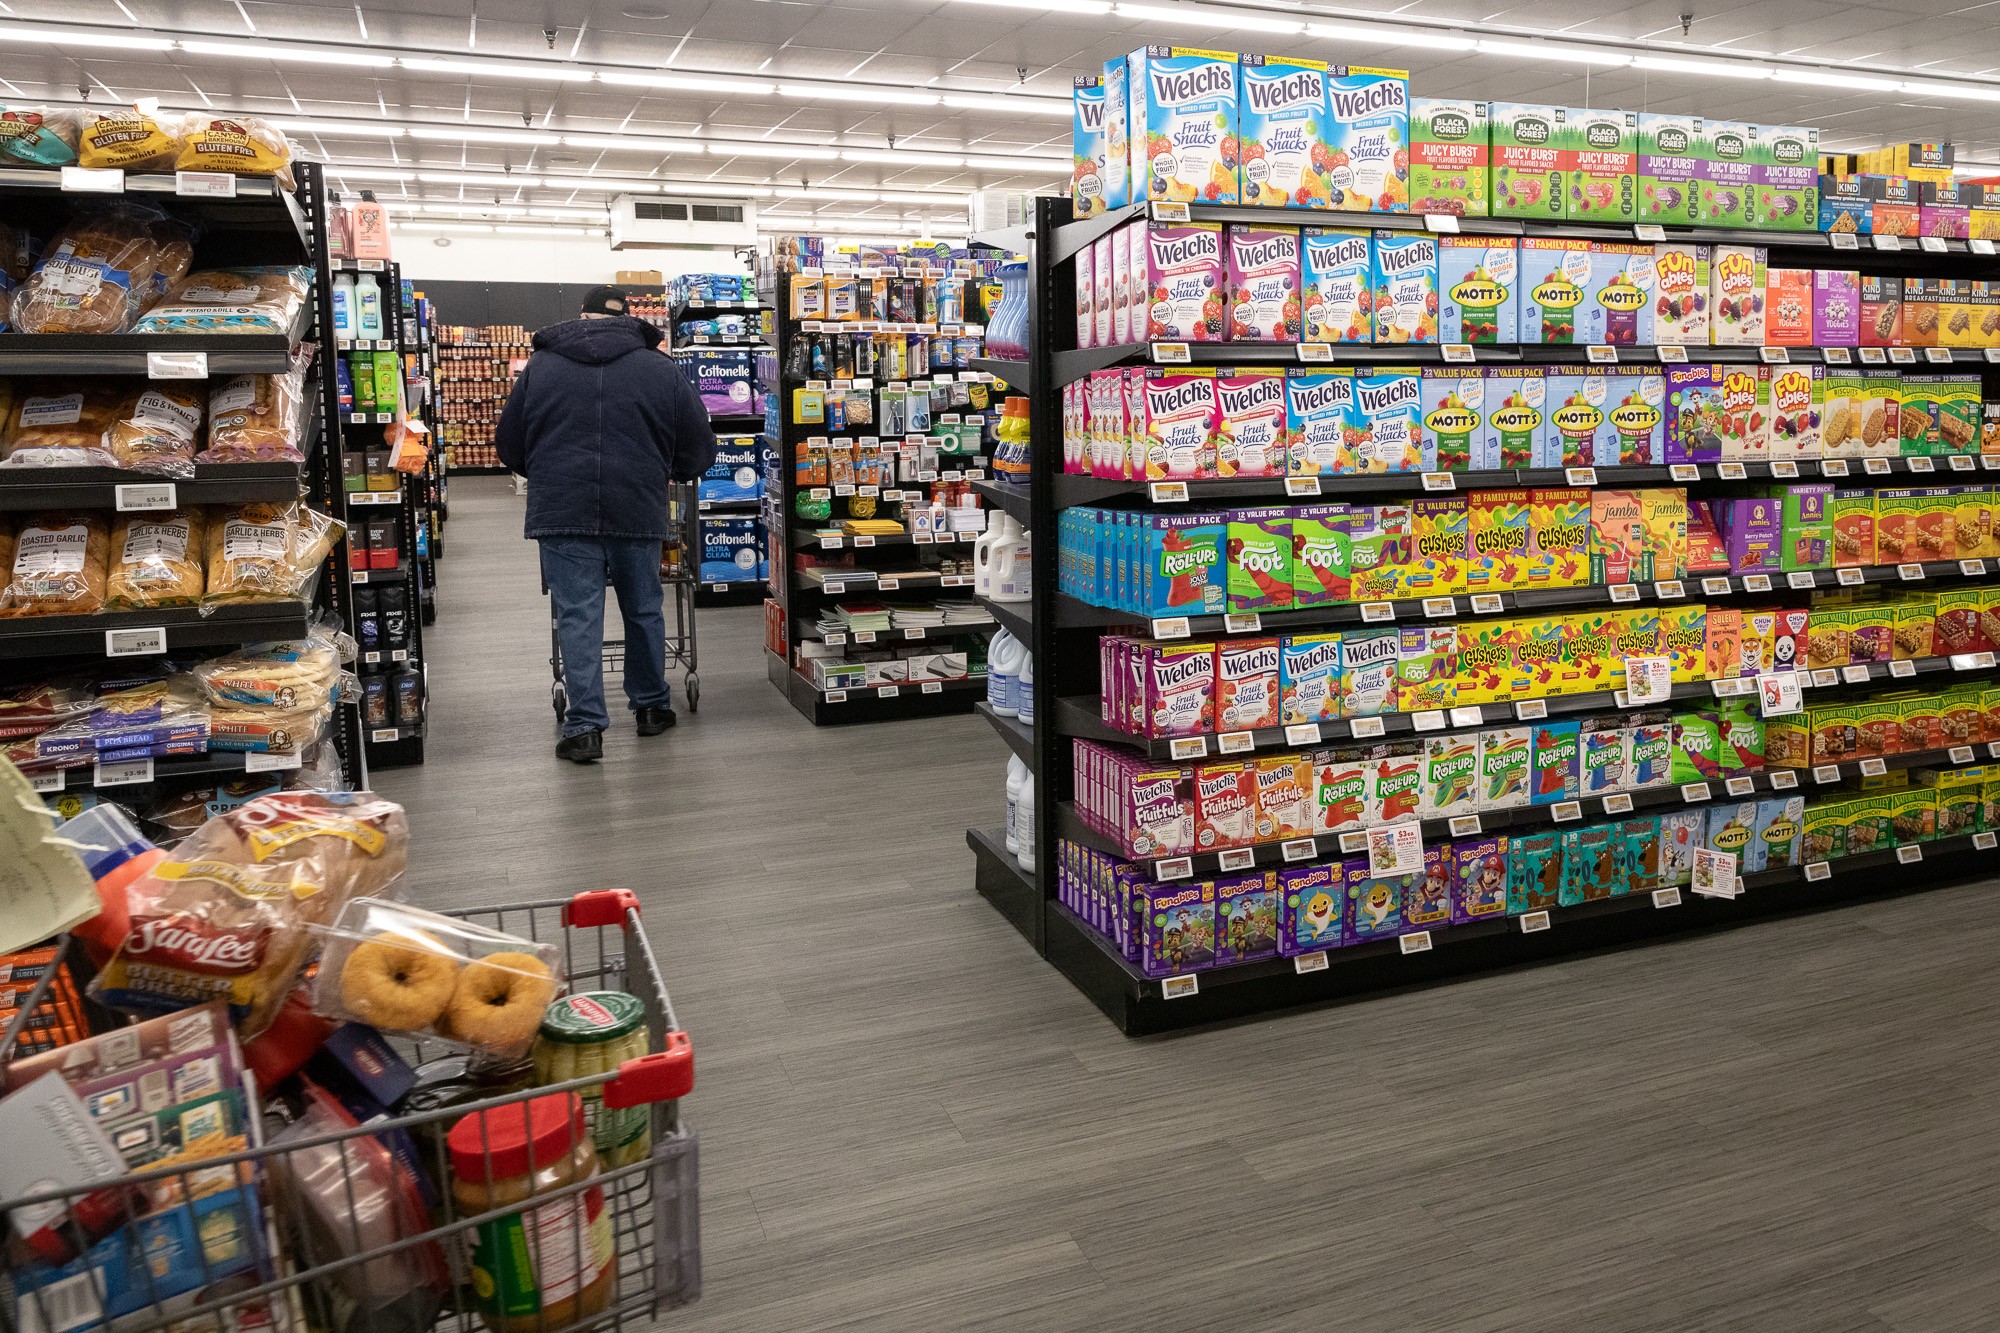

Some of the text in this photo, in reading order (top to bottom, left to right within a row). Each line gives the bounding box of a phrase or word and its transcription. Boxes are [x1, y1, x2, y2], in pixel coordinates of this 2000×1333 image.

[1154, 67, 1232, 99] Welch's
[1248, 74, 1322, 106] Welch's
[1332, 83, 1403, 117] Welch's
[1182, 121, 1203, 135] Fruit
[1519, 123, 1544, 131] BLACK
[94, 132, 149, 146] GLUTEN FREE
[208, 132, 244, 140] CANYON
[1173, 132, 1216, 147] Snacks
[1275, 127, 1294, 141] Fruit
[1516, 130, 1547, 138] FOREST
[197, 144, 254, 155] GLUTEN FREE
[1266, 138, 1307, 152] Snacks
[107, 149, 156, 164] Deli White
[1422, 145, 1477, 158] JUICY BURST
[1503, 147, 1558, 161] JUICY BURST
[1924, 151, 1940, 160] KIND
[1155, 161, 1174, 169] WHOLE
[1648, 157, 1696, 170] JUICY BURST
[1765, 166, 1812, 178] JUICY BURST
[1839, 183, 1858, 193] KIND
[1938, 190, 1956, 200] KIND
[1454, 238, 1486, 247] FAMILY
[1489, 239, 1512, 248] PACK
[1154, 235, 1216, 265] Welch's
[1310, 240, 1366, 265] Welch's
[1490, 258, 1508, 266] FRUIT
[1489, 264, 1513, 273] VEGGIE
[1177, 279, 1200, 291] Fruit
[1169, 288, 1205, 301] Snacks
[1456, 288, 1503, 300] MOTT'S
[1603, 293, 1642, 304] MOTT'S
[698, 365, 749, 378] Cottonelle
[1434, 368, 1457, 378] VALUE
[1459, 368, 1482, 378] PACK
[141, 397, 158, 406] FIG
[1151, 379, 1211, 412] Welch's
[1292, 382, 1350, 412] Welch's
[1431, 416, 1475, 426] MOTT'S
[1558, 412, 1599, 424] MOTT'S
[1484, 494, 1504, 502] FAMILY
[1507, 492, 1526, 500] PACK
[1605, 503, 1638, 523] jamba
[1200, 516, 1220, 524] PACK
[160, 528, 187, 539] HERBS
[226, 528, 252, 538] GARLIC
[21, 534, 85, 546] ROASTED GARLIC
[705, 534, 755, 545] Cottonelle
[1713, 614, 1735, 624] SOLELY
[1346, 640, 1396, 665] Welch's
[1157, 655, 1210, 685] Welch's
[224, 681, 254, 689] WHITE
[104, 735, 149, 746] PITA BREAD
[47, 743, 79, 752] KRONOS
[1133, 782, 1172, 803] Welch's
[1766, 826, 1798, 838] MOTT'S
[1288, 871, 1328, 888] Funables
[1155, 890, 1198, 909] Funables
